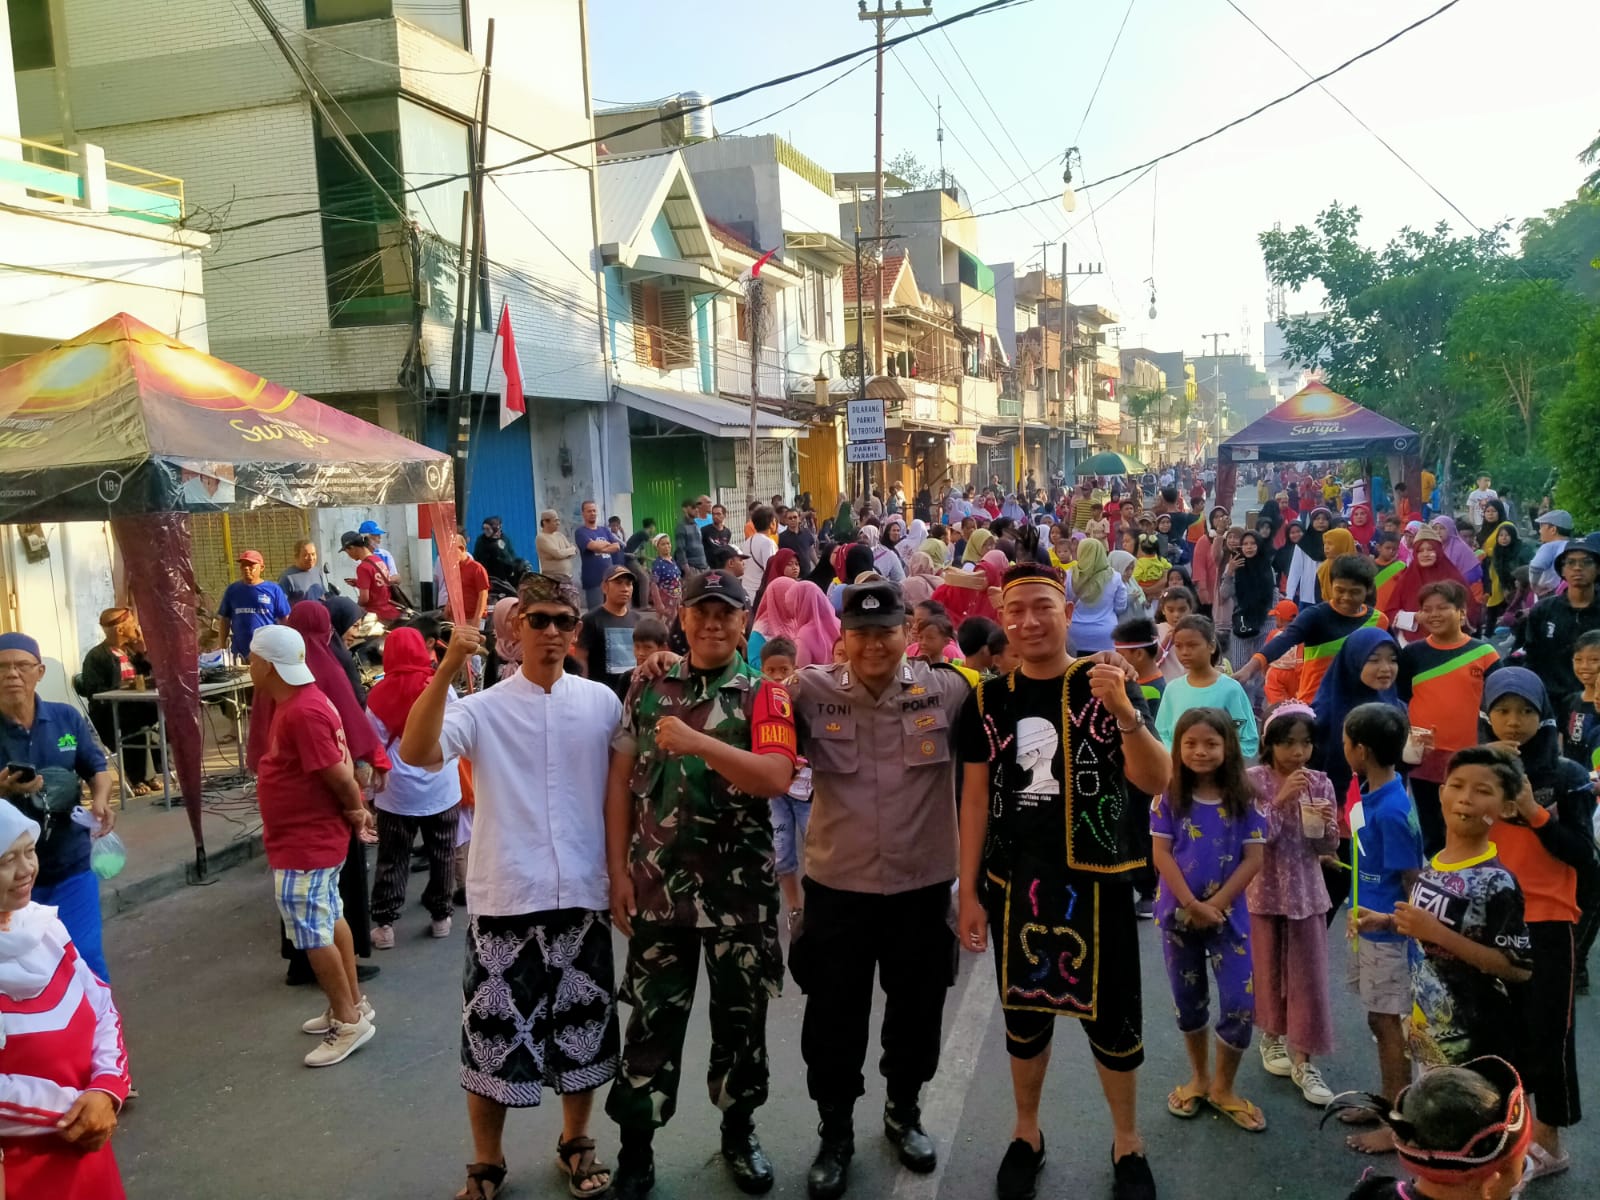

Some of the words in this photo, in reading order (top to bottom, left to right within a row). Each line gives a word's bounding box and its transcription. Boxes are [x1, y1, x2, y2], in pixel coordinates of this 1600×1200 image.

[229, 419, 329, 448] Surya
[1290, 425, 1346, 435] Surya
[818, 703, 852, 715] TONI
[902, 696, 940, 713] POLRI
